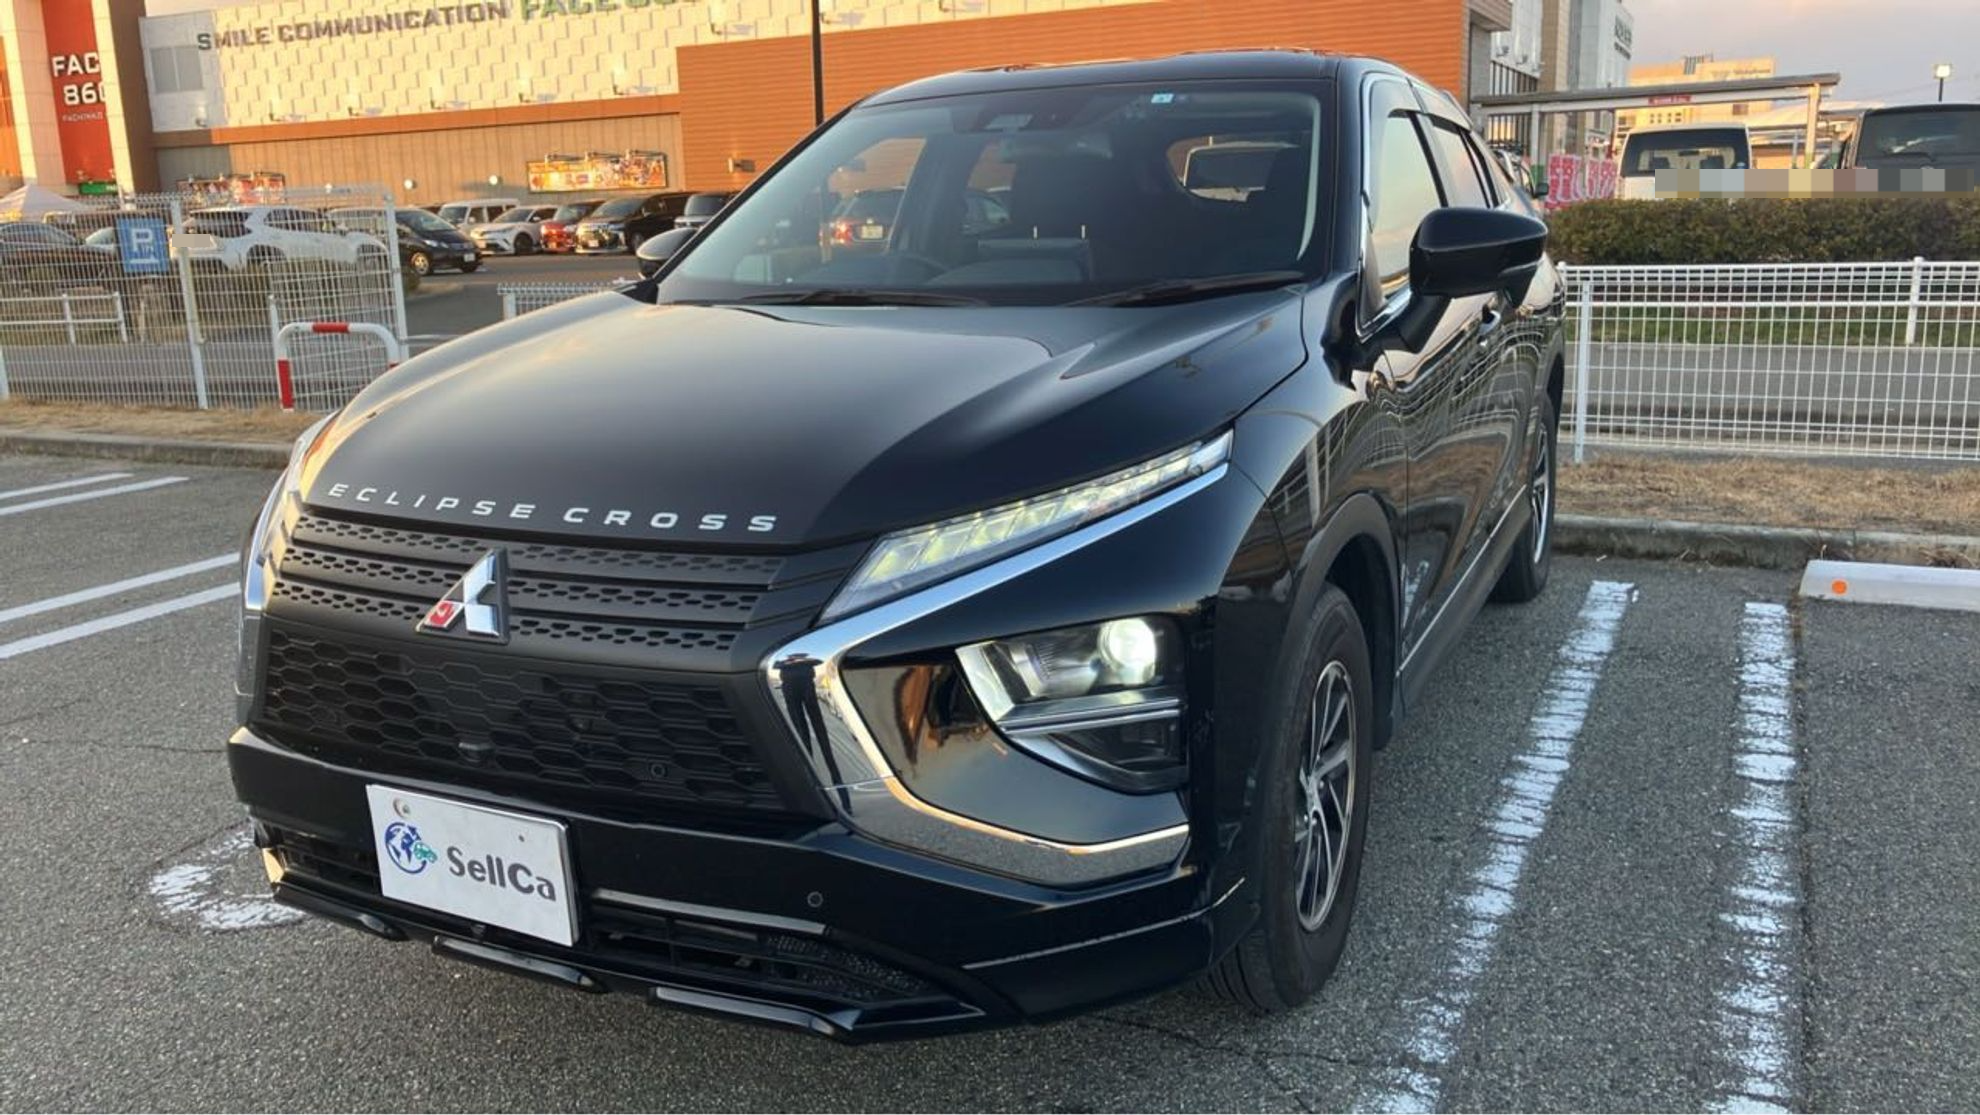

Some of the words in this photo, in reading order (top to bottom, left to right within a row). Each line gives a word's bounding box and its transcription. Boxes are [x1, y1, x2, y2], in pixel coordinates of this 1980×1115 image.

[197, 26, 272, 50] SMILE
[278, 1, 509, 42] COMMUNICATION
[52, 52, 100, 77] FAC
[328, 483, 536, 518] ECLIPSE
[563, 507, 777, 532] CROSS
[447, 846, 557, 901] SellCa
